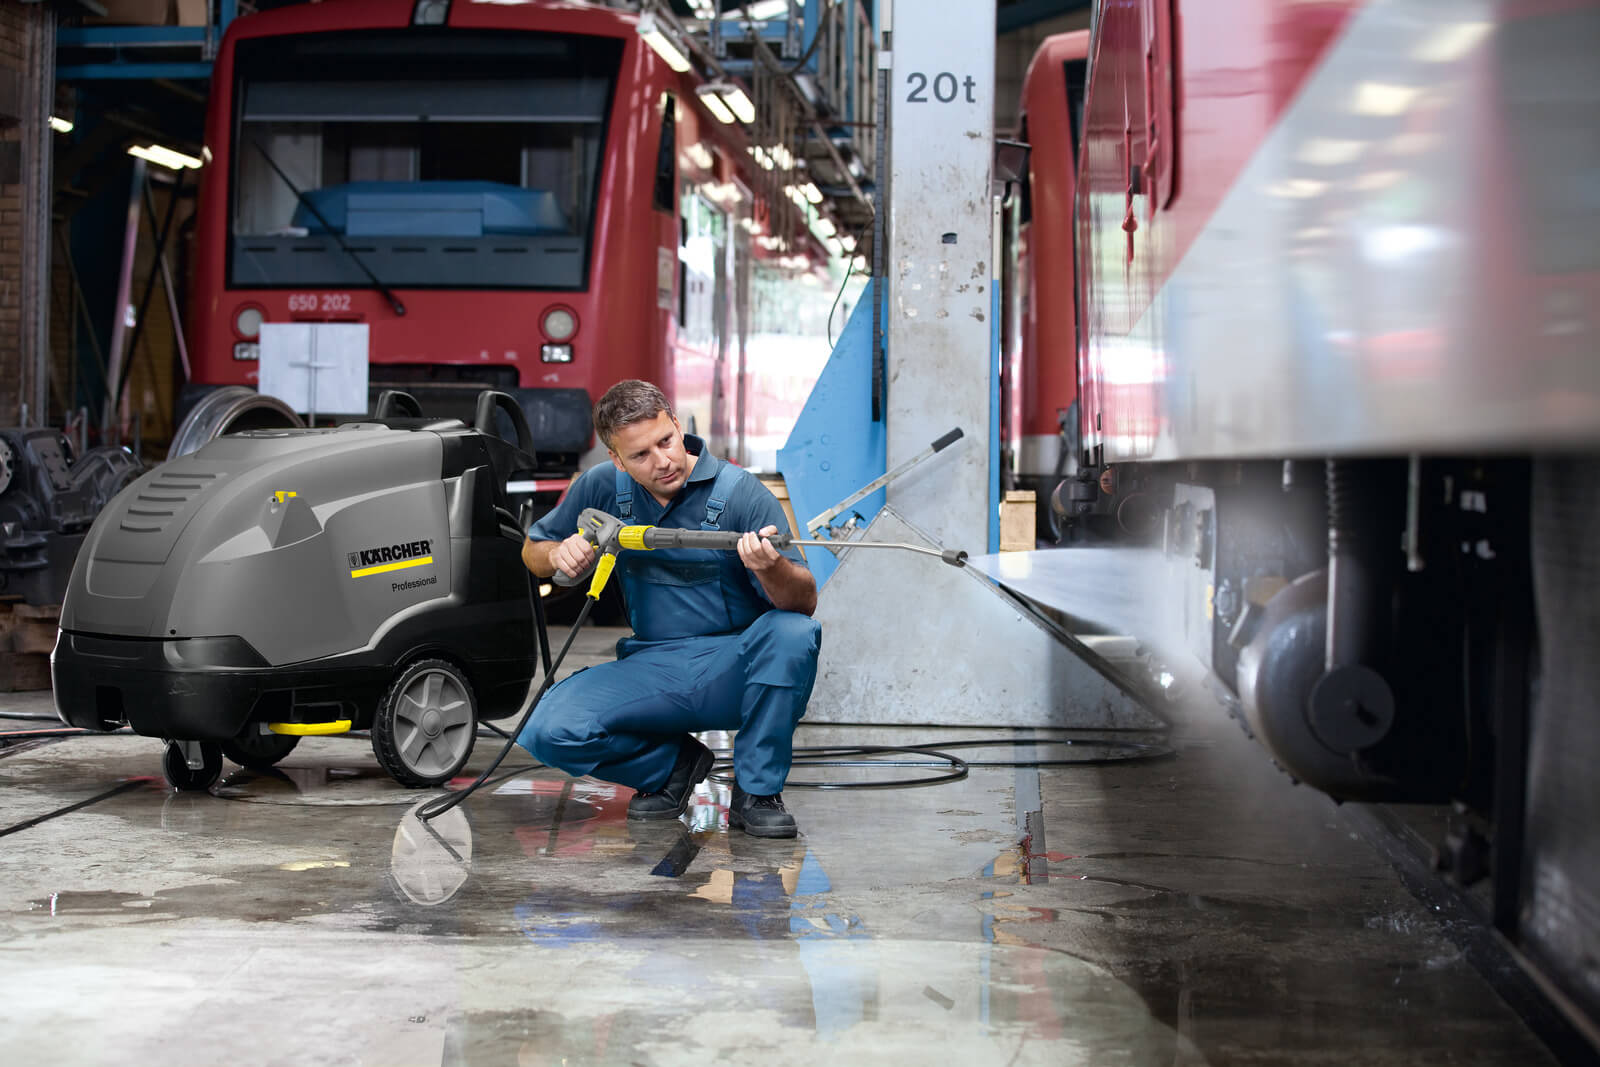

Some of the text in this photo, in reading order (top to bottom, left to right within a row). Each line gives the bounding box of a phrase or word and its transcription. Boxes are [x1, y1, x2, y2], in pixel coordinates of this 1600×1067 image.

[906, 71, 976, 103] 20t
[288, 294, 351, 311] 650 202
[359, 540, 432, 566] KÄRCHER
[392, 576, 437, 592] Professional
